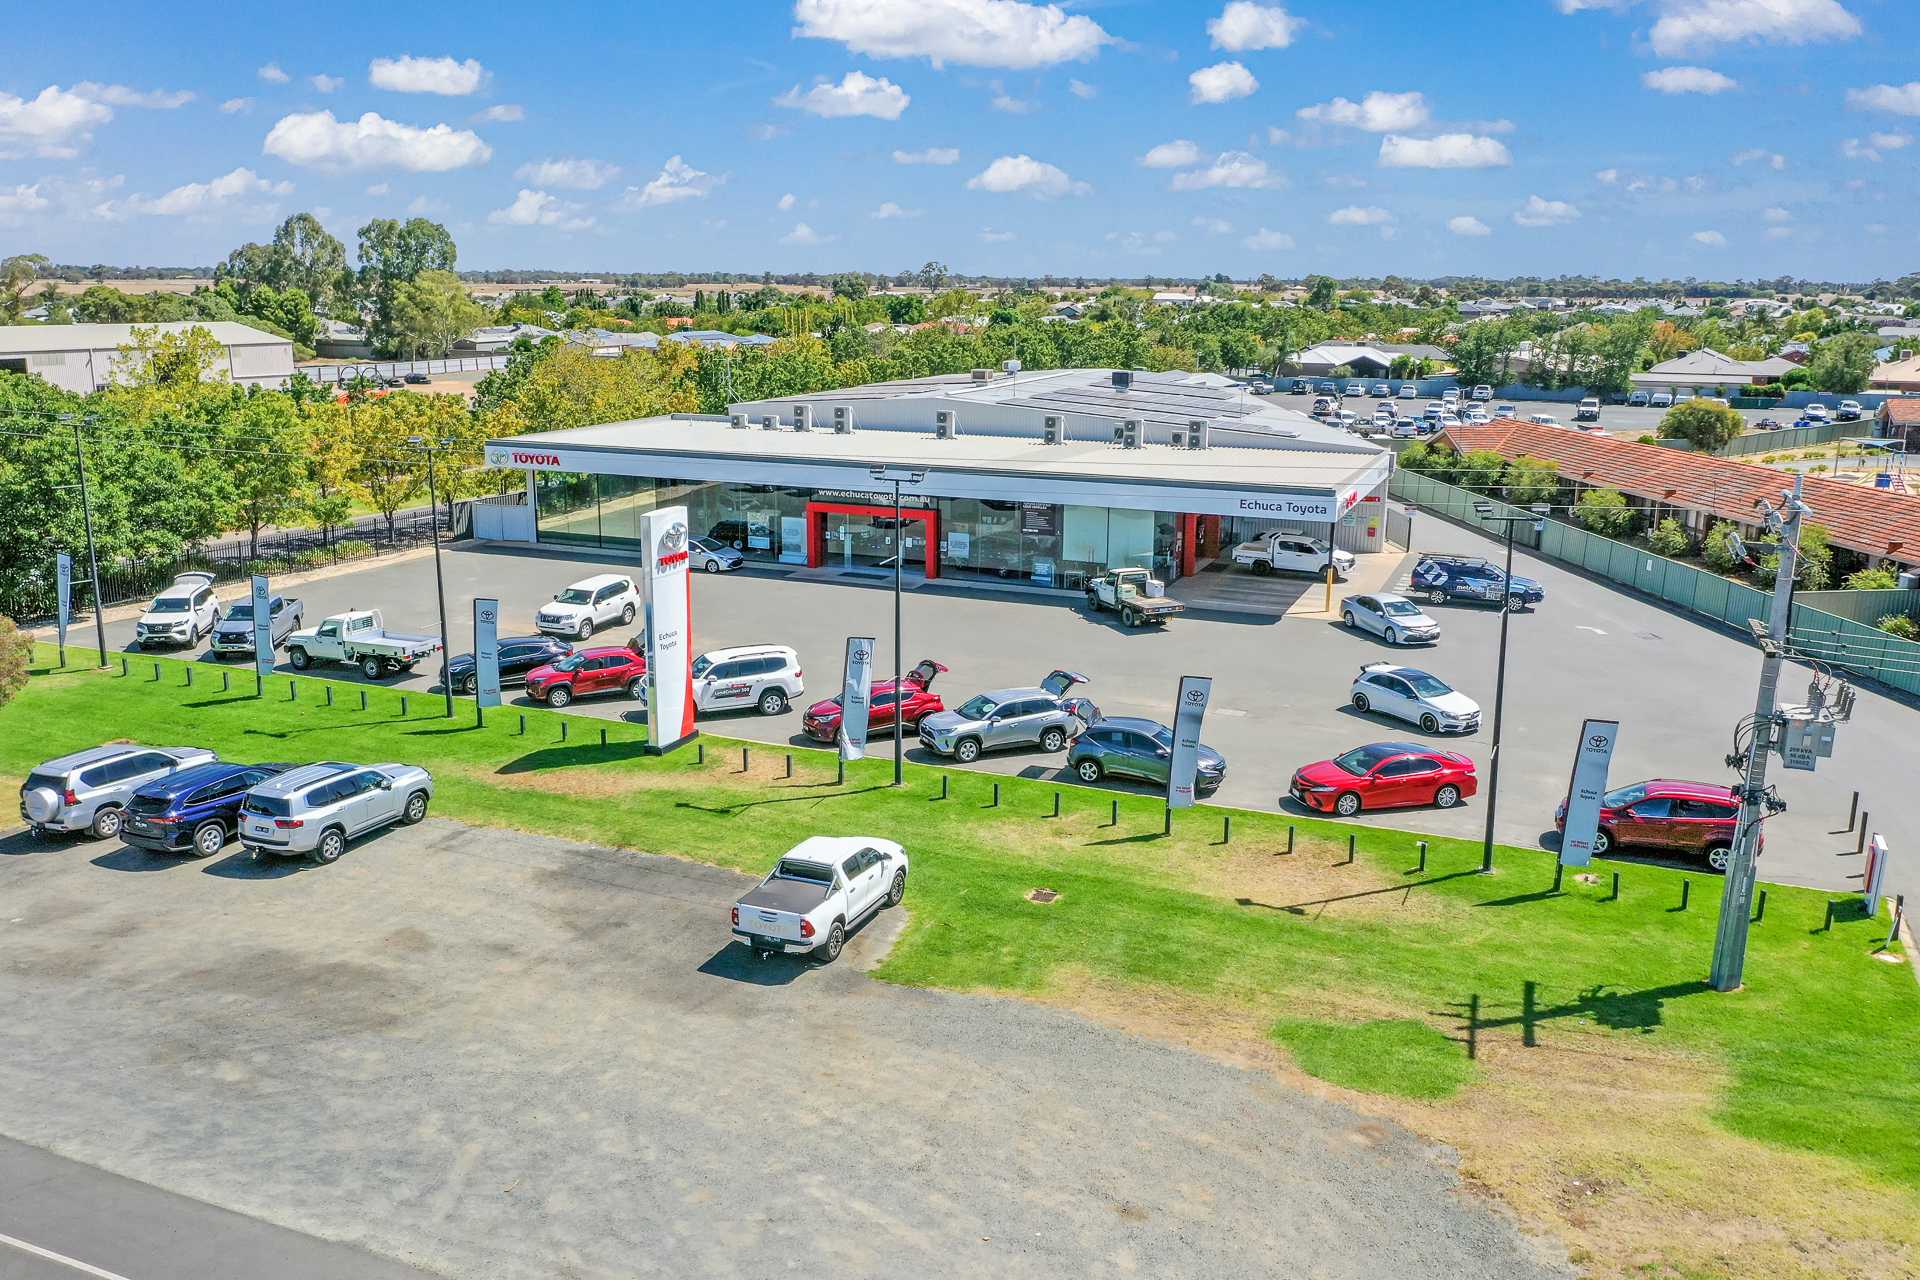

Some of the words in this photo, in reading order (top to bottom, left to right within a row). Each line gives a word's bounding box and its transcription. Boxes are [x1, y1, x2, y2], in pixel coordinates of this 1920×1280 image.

[511, 452, 561, 466] TOYOTA
[818, 488, 931, 504] www.echucatoyotacom.au
[1239, 499, 1283, 512] Echuca
[1286, 502, 1327, 515] Toyota
